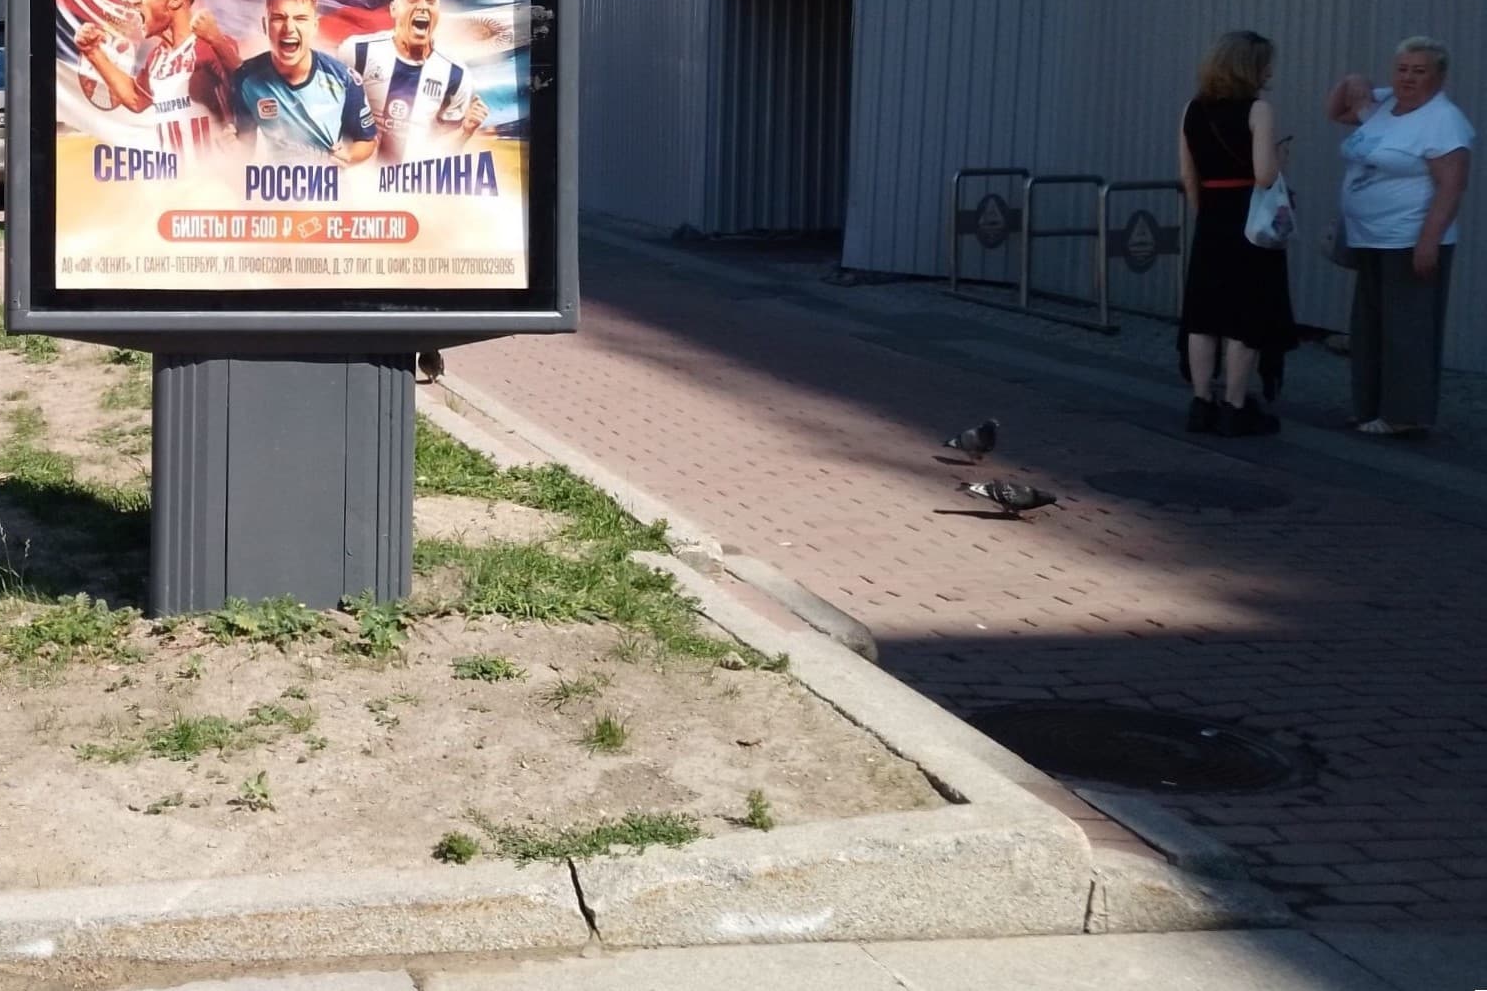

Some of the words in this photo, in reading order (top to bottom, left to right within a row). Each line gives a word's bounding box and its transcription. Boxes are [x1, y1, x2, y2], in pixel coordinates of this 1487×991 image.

[94, 143, 178, 183] СЕРБИЯ
[379, 150, 498, 197] АРГЕНТИНА
[245, 165, 338, 202] РОССИЯ
[172, 216, 226, 238] БИЛЕТЫ
[231, 216, 247, 238] ОТ
[251, 216, 277, 238] 500
[327, 217, 407, 239] FC-ZENIT.RU
